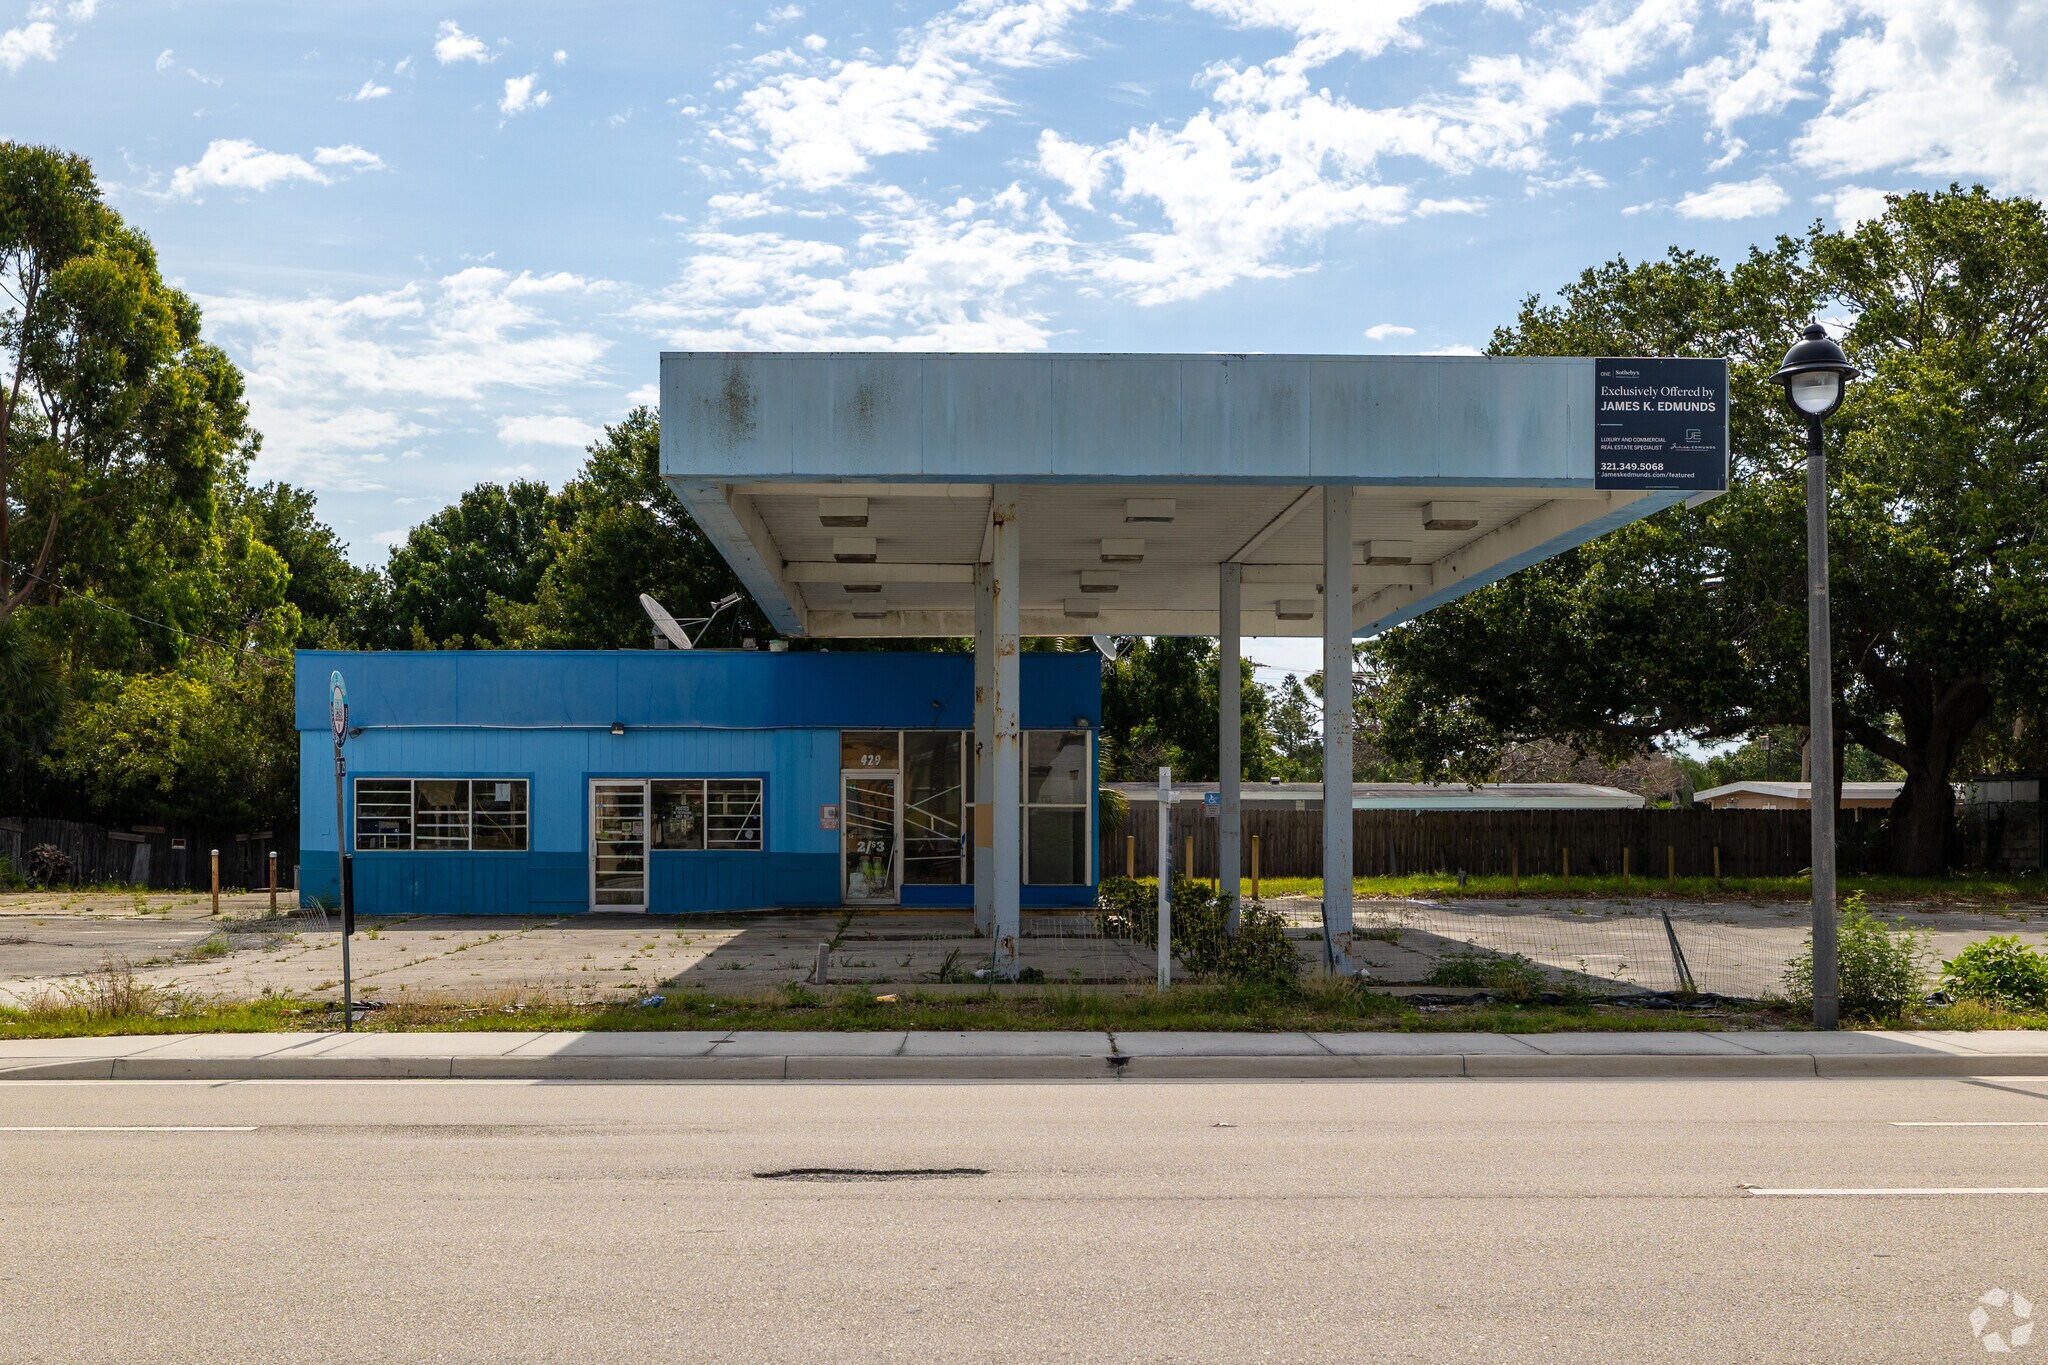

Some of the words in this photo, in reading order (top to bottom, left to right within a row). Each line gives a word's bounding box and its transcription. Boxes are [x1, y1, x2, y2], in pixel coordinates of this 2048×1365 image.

[1600, 385, 1658, 399] Exclusively
[1660, 386, 1700, 397] Offered
[1702, 387, 1715, 399] by
[1600, 401, 1640, 411] JAMES
[1643, 401, 1655, 411] K.
[1657, 401, 1716, 412] EDMUNDS
[1600, 462, 1664, 471] 321.349.5068
[861, 754, 881, 766] 429
